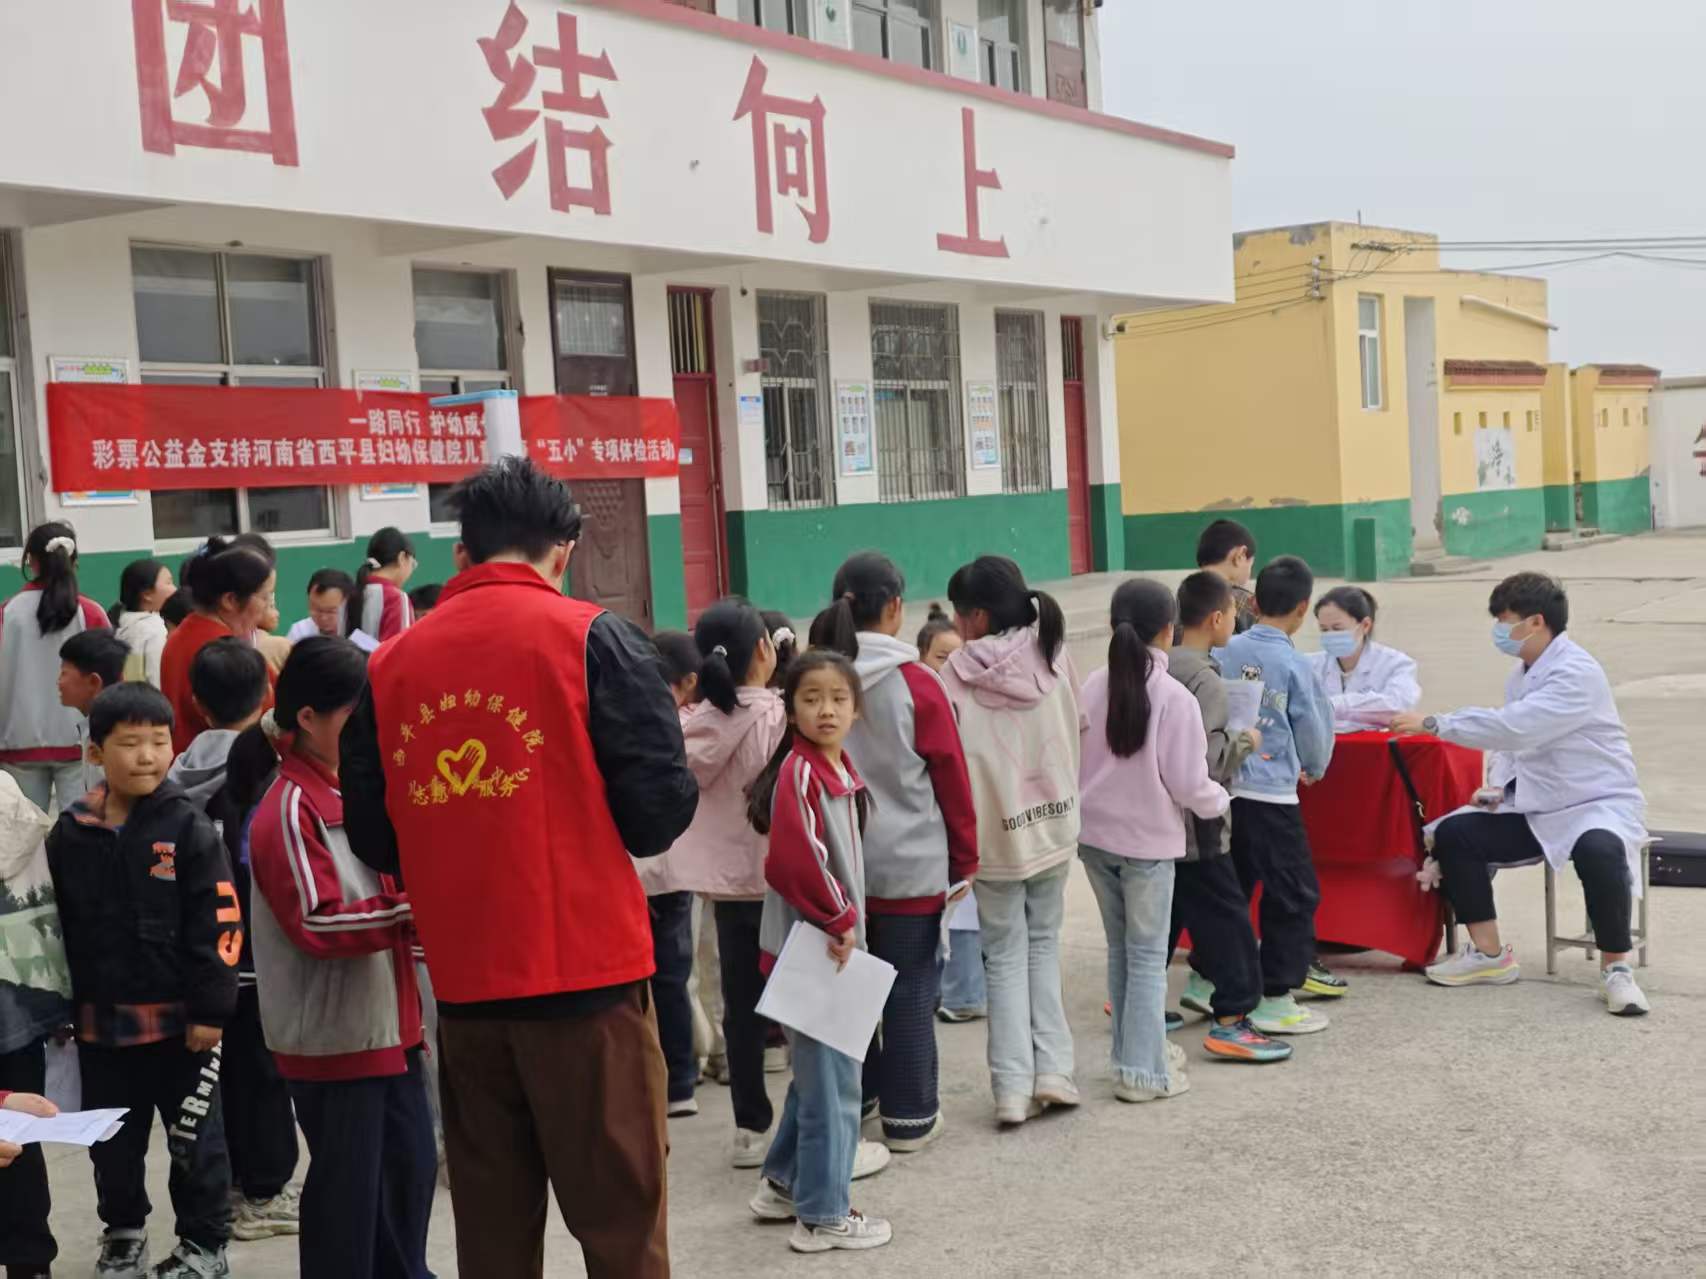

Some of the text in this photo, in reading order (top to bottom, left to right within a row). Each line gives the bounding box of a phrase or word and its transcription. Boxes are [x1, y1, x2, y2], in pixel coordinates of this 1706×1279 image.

[131, 0, 1009, 258] 团结向上
[349, 408, 486, 437] 一路同行 护幼成
